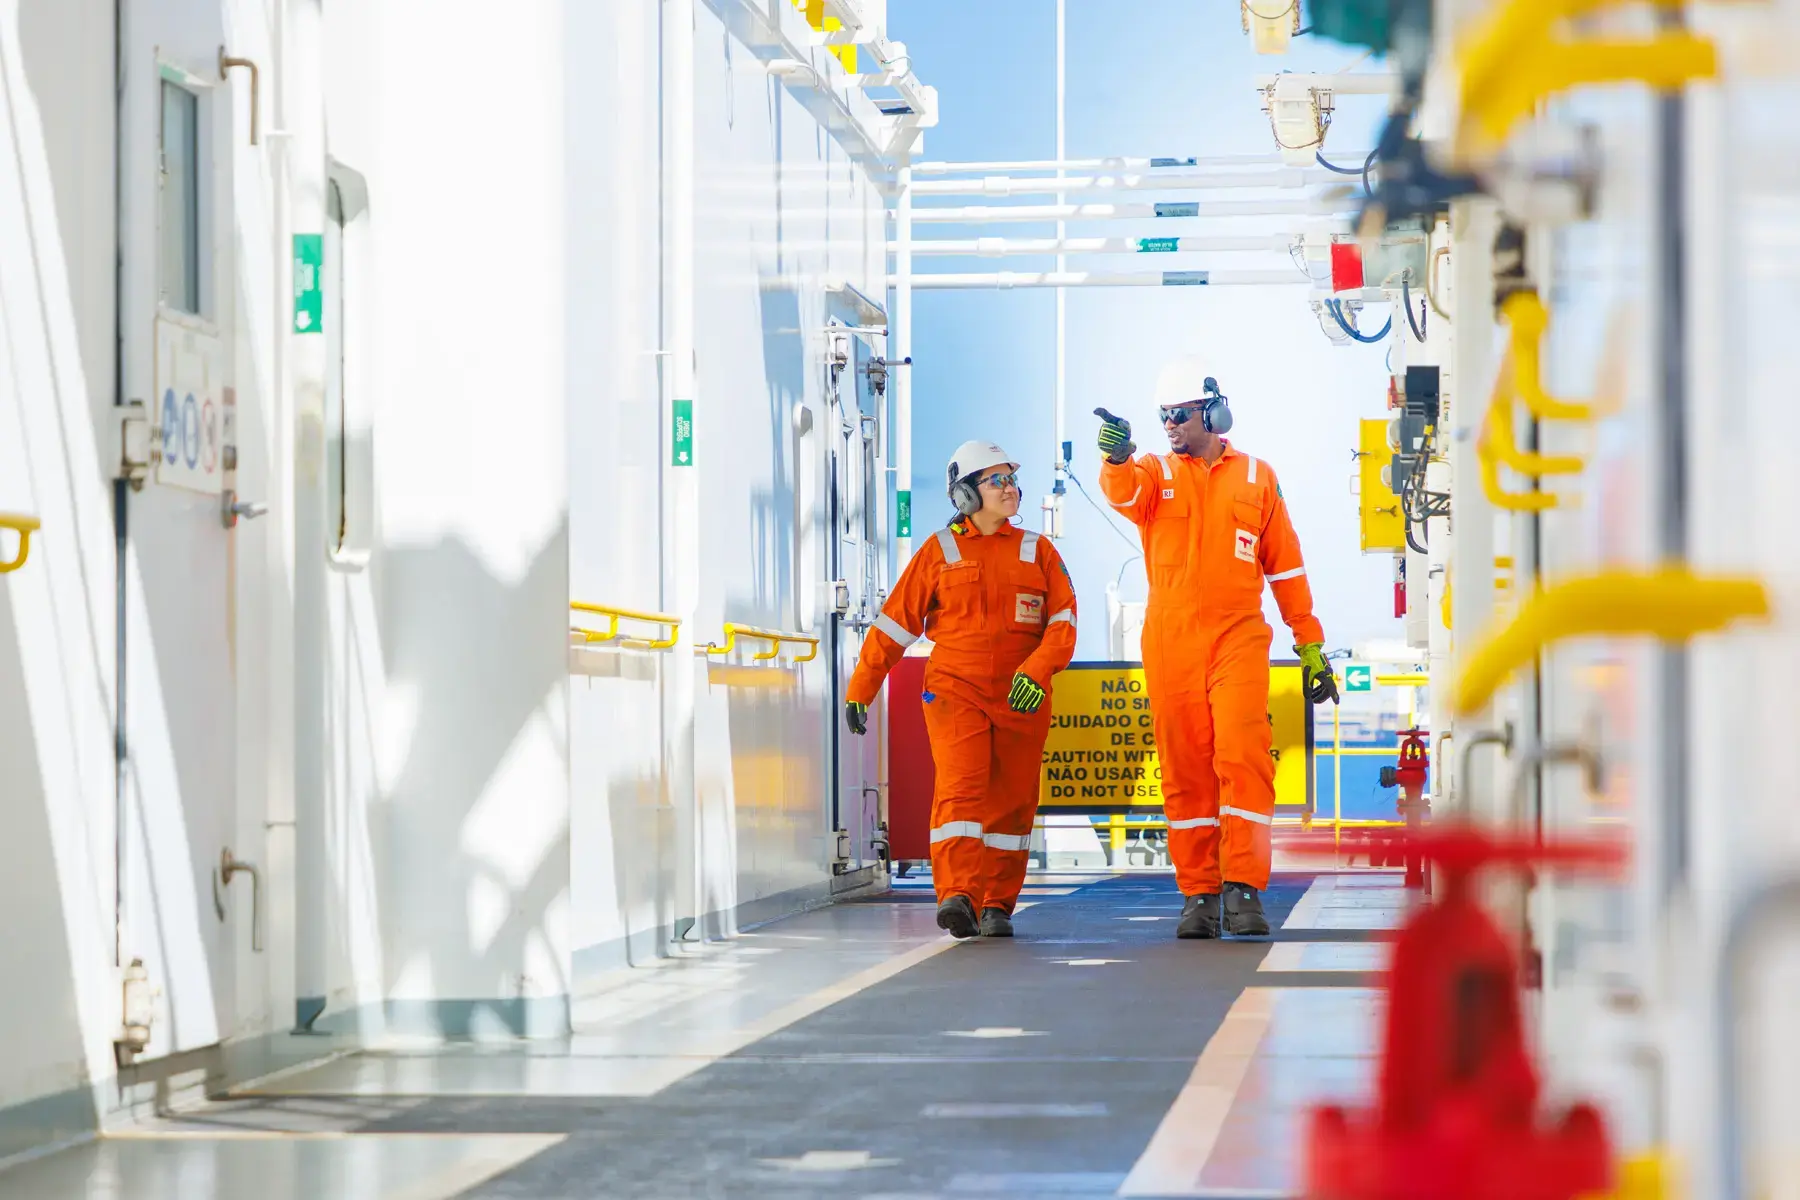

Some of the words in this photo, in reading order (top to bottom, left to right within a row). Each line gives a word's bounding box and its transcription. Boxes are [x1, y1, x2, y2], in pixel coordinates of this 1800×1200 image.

[1101, 677, 1142, 693] NÃO
[1101, 698, 1126, 710] NO
[1111, 732, 1135, 746] DE
[1047, 764, 1088, 780] NÃO
[1094, 767, 1146, 780] USAR
[1051, 785, 1075, 798] DO
[1081, 785, 1118, 797] NOT
[1123, 785, 1158, 797] USE
